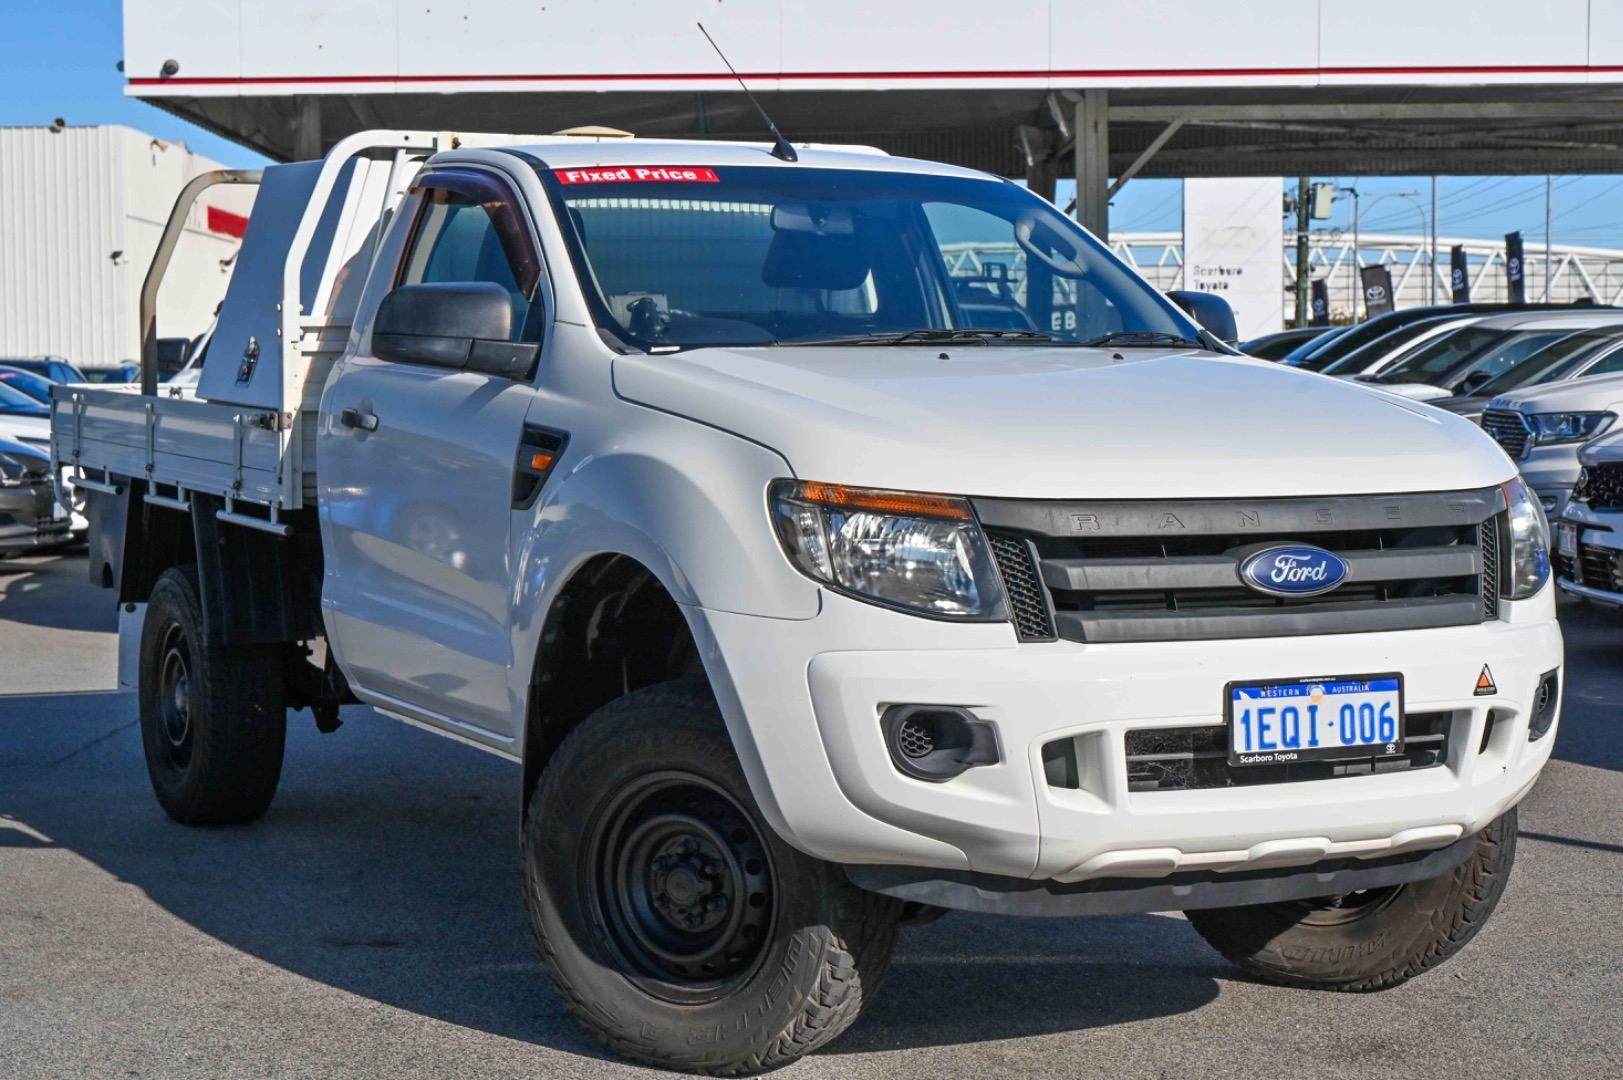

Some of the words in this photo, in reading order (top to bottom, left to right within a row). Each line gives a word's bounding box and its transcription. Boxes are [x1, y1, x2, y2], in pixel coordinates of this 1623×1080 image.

[566, 168, 631, 182] Fixed
[633, 168, 697, 180] Price
[1270, 554, 1328, 583] Ford
[1260, 689, 1300, 698] WESTERN
[1332, 685, 1370, 693] AUSTRALIA
[1240, 754, 1273, 763] Scarboro
[1274, 753, 1298, 761] Toyota
